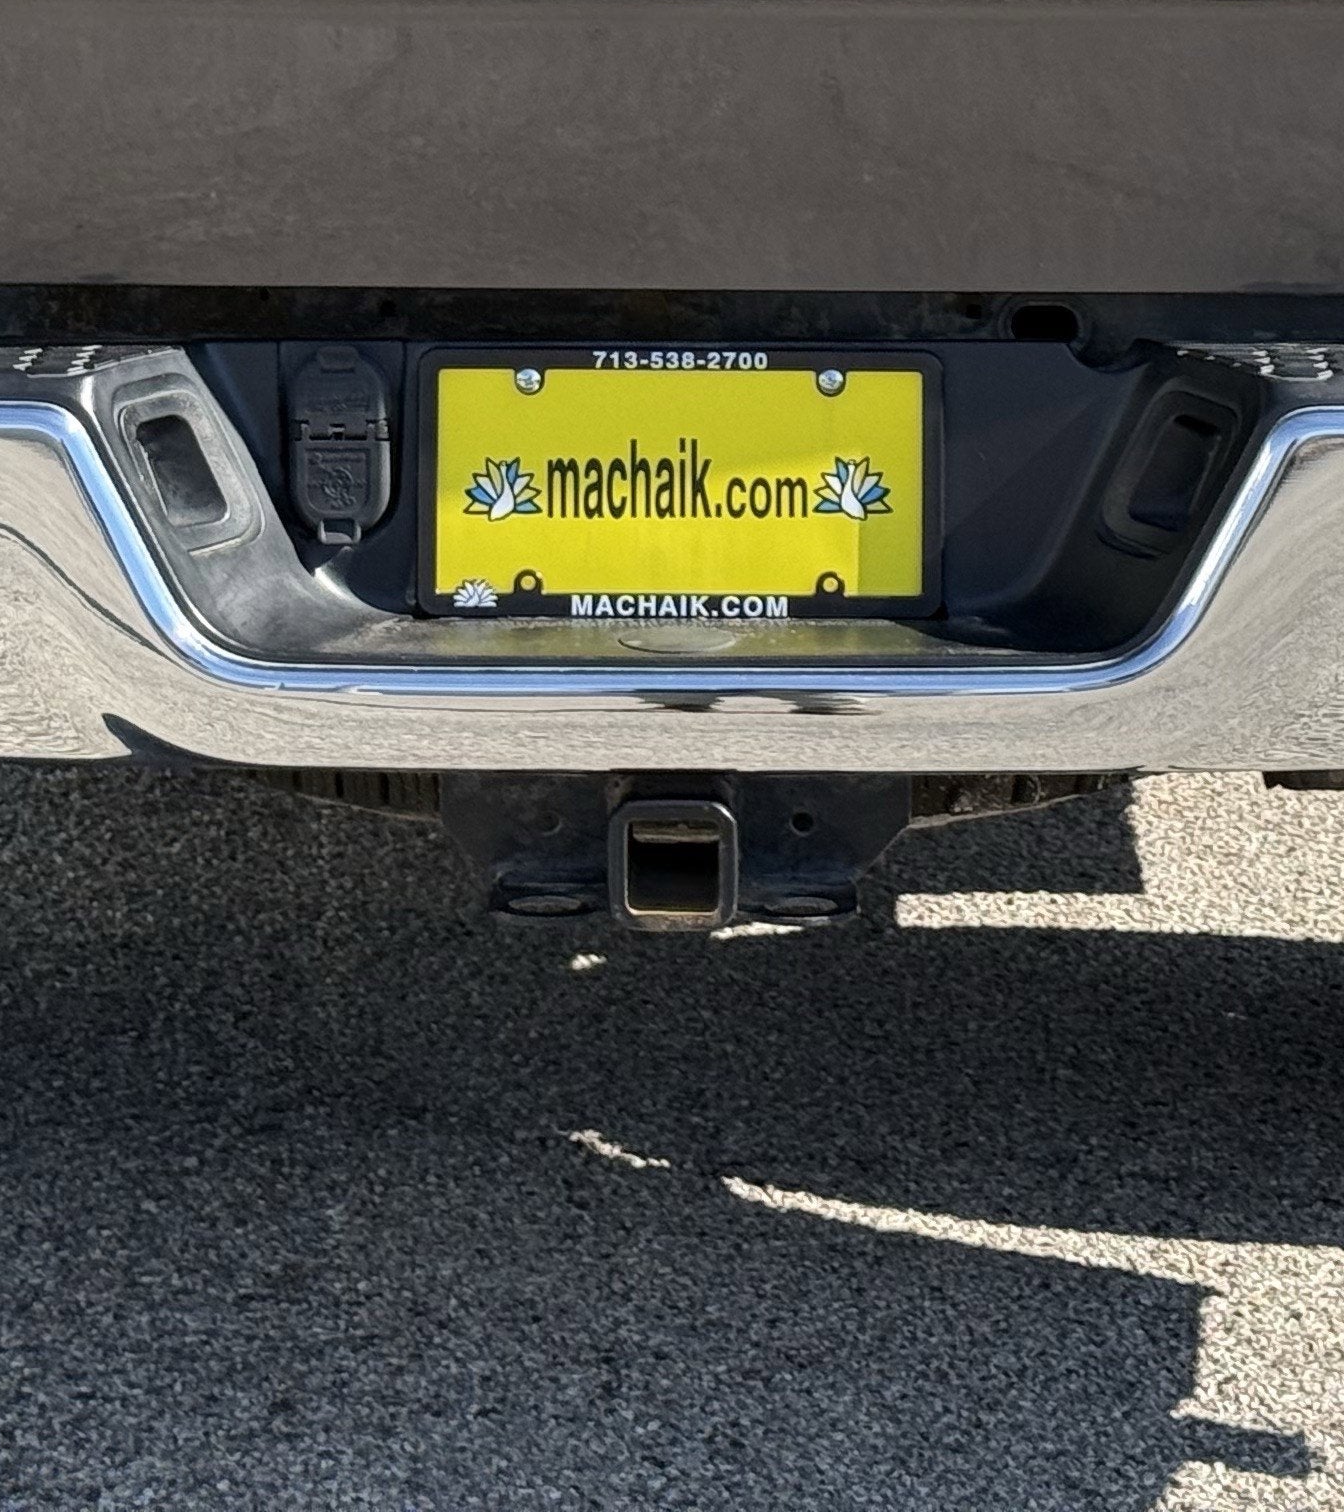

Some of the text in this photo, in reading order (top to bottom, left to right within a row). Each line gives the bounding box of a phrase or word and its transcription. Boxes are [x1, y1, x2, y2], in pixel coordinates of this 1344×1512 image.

[592, 350, 769, 371] 713-538-2700
[546, 437, 809, 519] machaik.com
[570, 595, 788, 618] MACHAIK.COM
